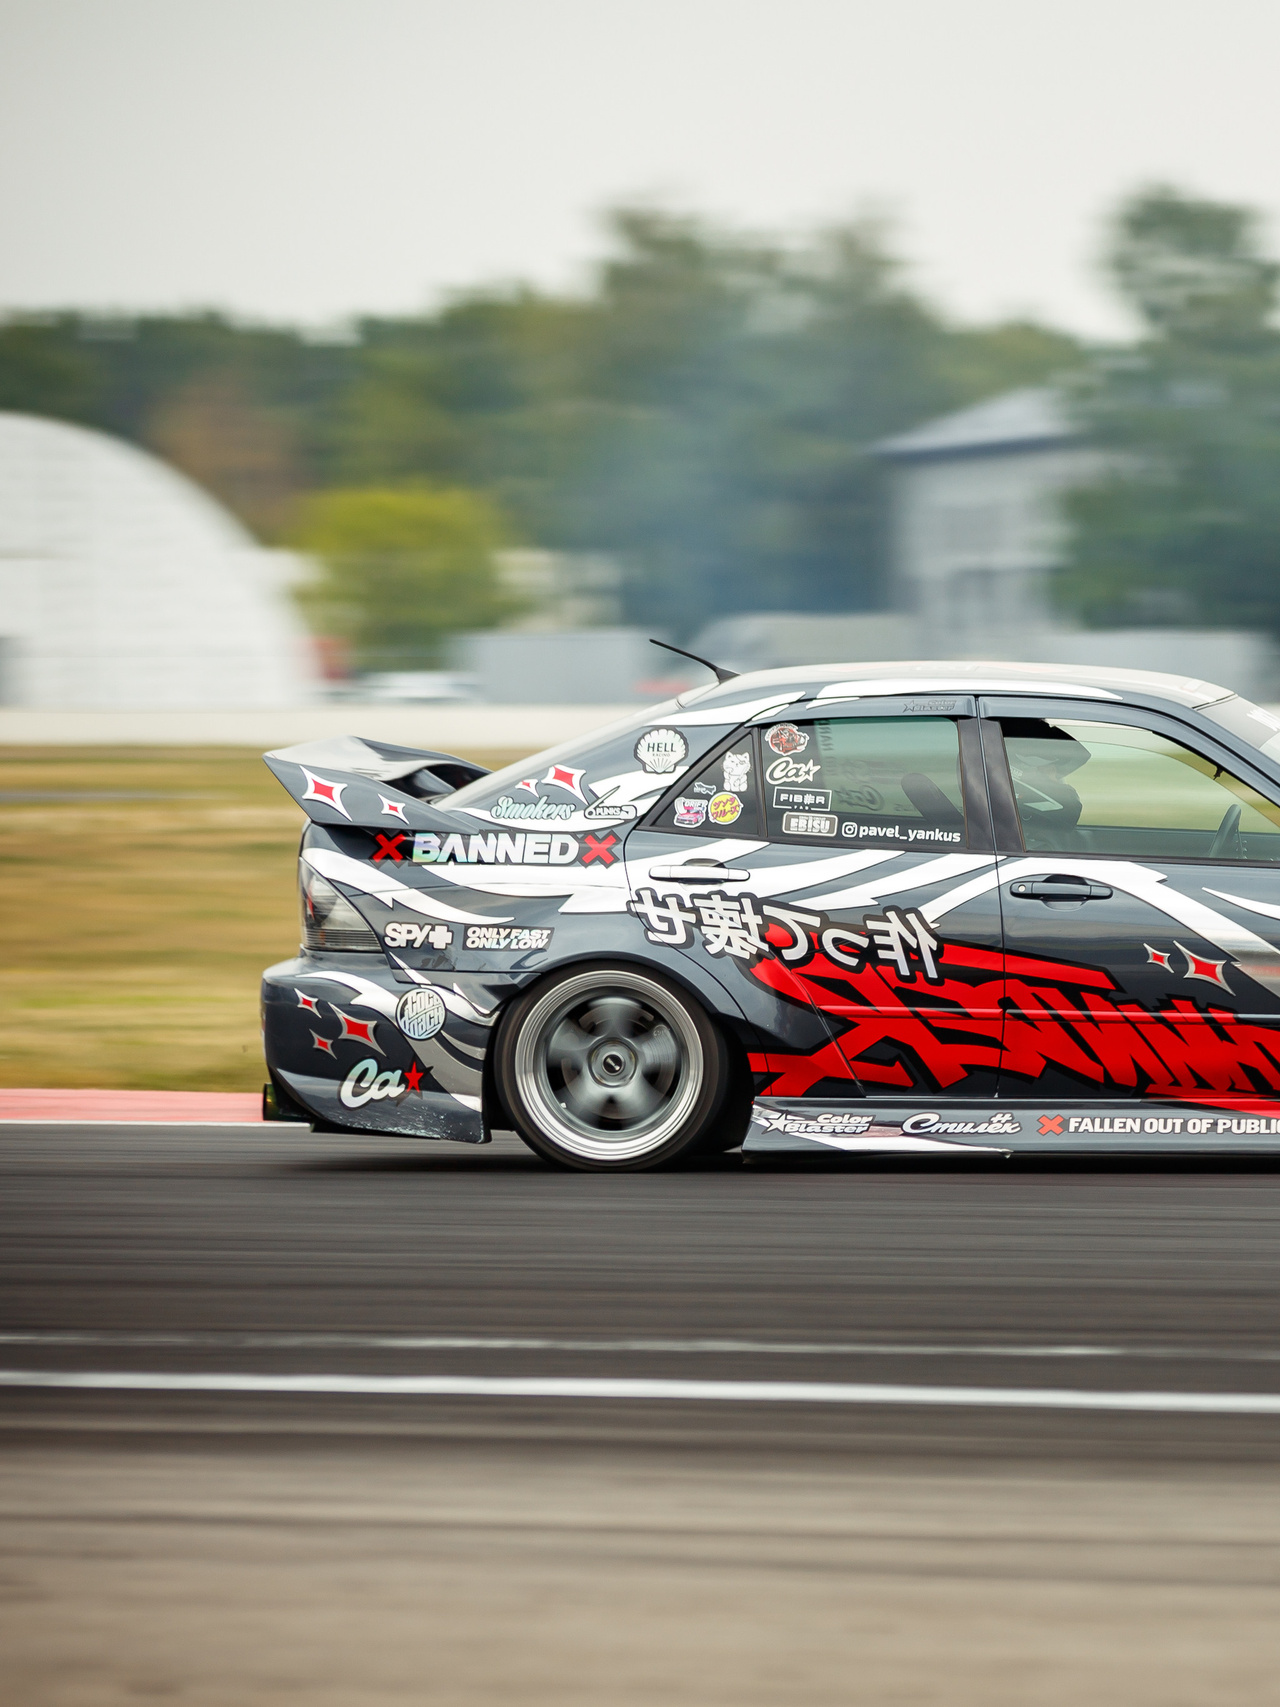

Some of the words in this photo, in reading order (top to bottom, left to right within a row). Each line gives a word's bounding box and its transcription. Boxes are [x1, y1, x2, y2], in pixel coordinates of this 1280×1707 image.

[646, 742, 677, 753] HELL
[490, 795, 577, 821] Smokers
[790, 816, 831, 833] EBISU
[858, 825, 962, 843] pavel_yankus
[412, 832, 580, 864] BANNED
[467, 926, 512, 939] ONLY
[509, 928, 551, 940] FAST
[465, 937, 512, 949] ONLY
[510, 938, 549, 950] LOW
[816, 1112, 874, 1124] Color
[1068, 1117, 1142, 1134] FALLEN
[1144, 1118, 1184, 1134] OUT
[1186, 1118, 1214, 1134] OF
[785, 1122, 871, 1134] Blaster
